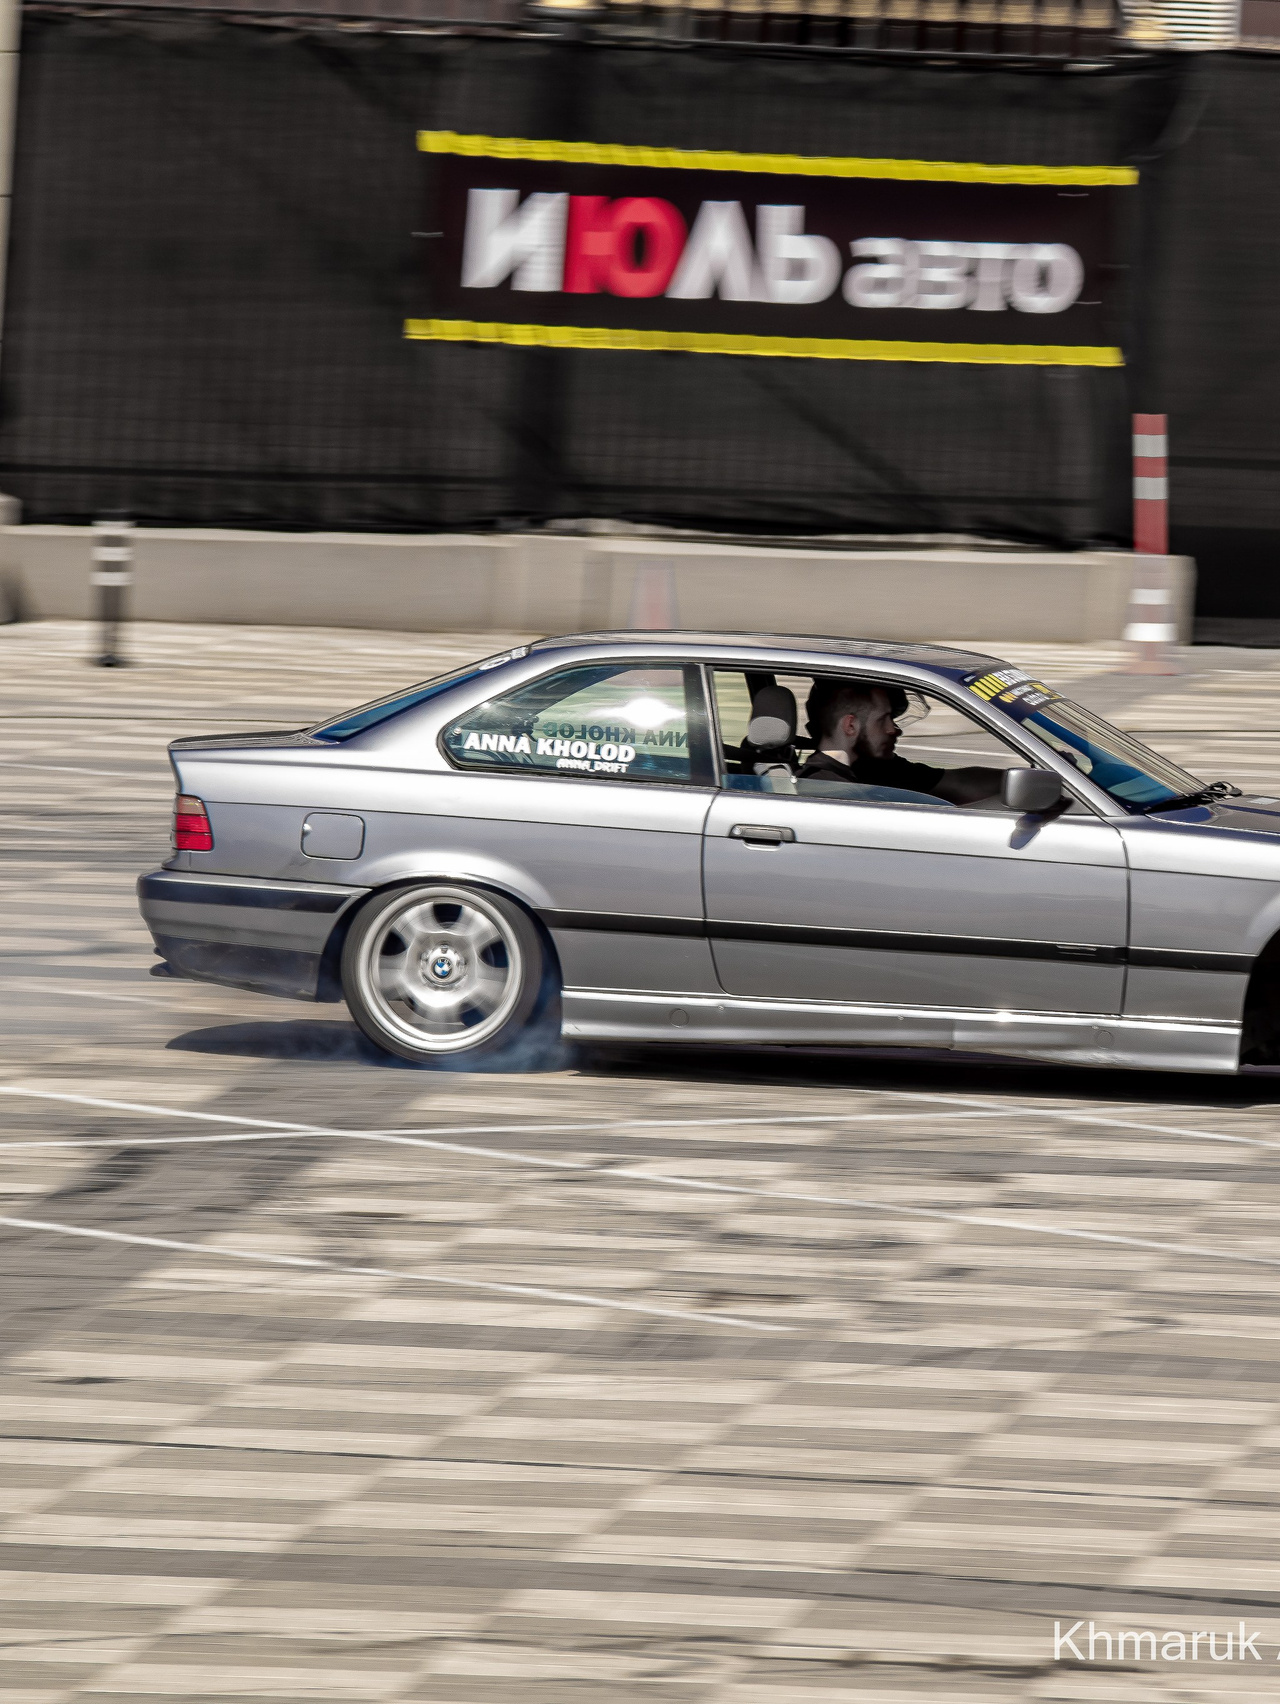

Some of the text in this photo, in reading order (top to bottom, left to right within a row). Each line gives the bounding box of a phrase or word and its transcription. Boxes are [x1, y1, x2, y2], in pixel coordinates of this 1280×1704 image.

[461, 188, 1085, 314] ИЮЛЬ авто
[464, 732, 636, 763] ANNA KHOLOD
